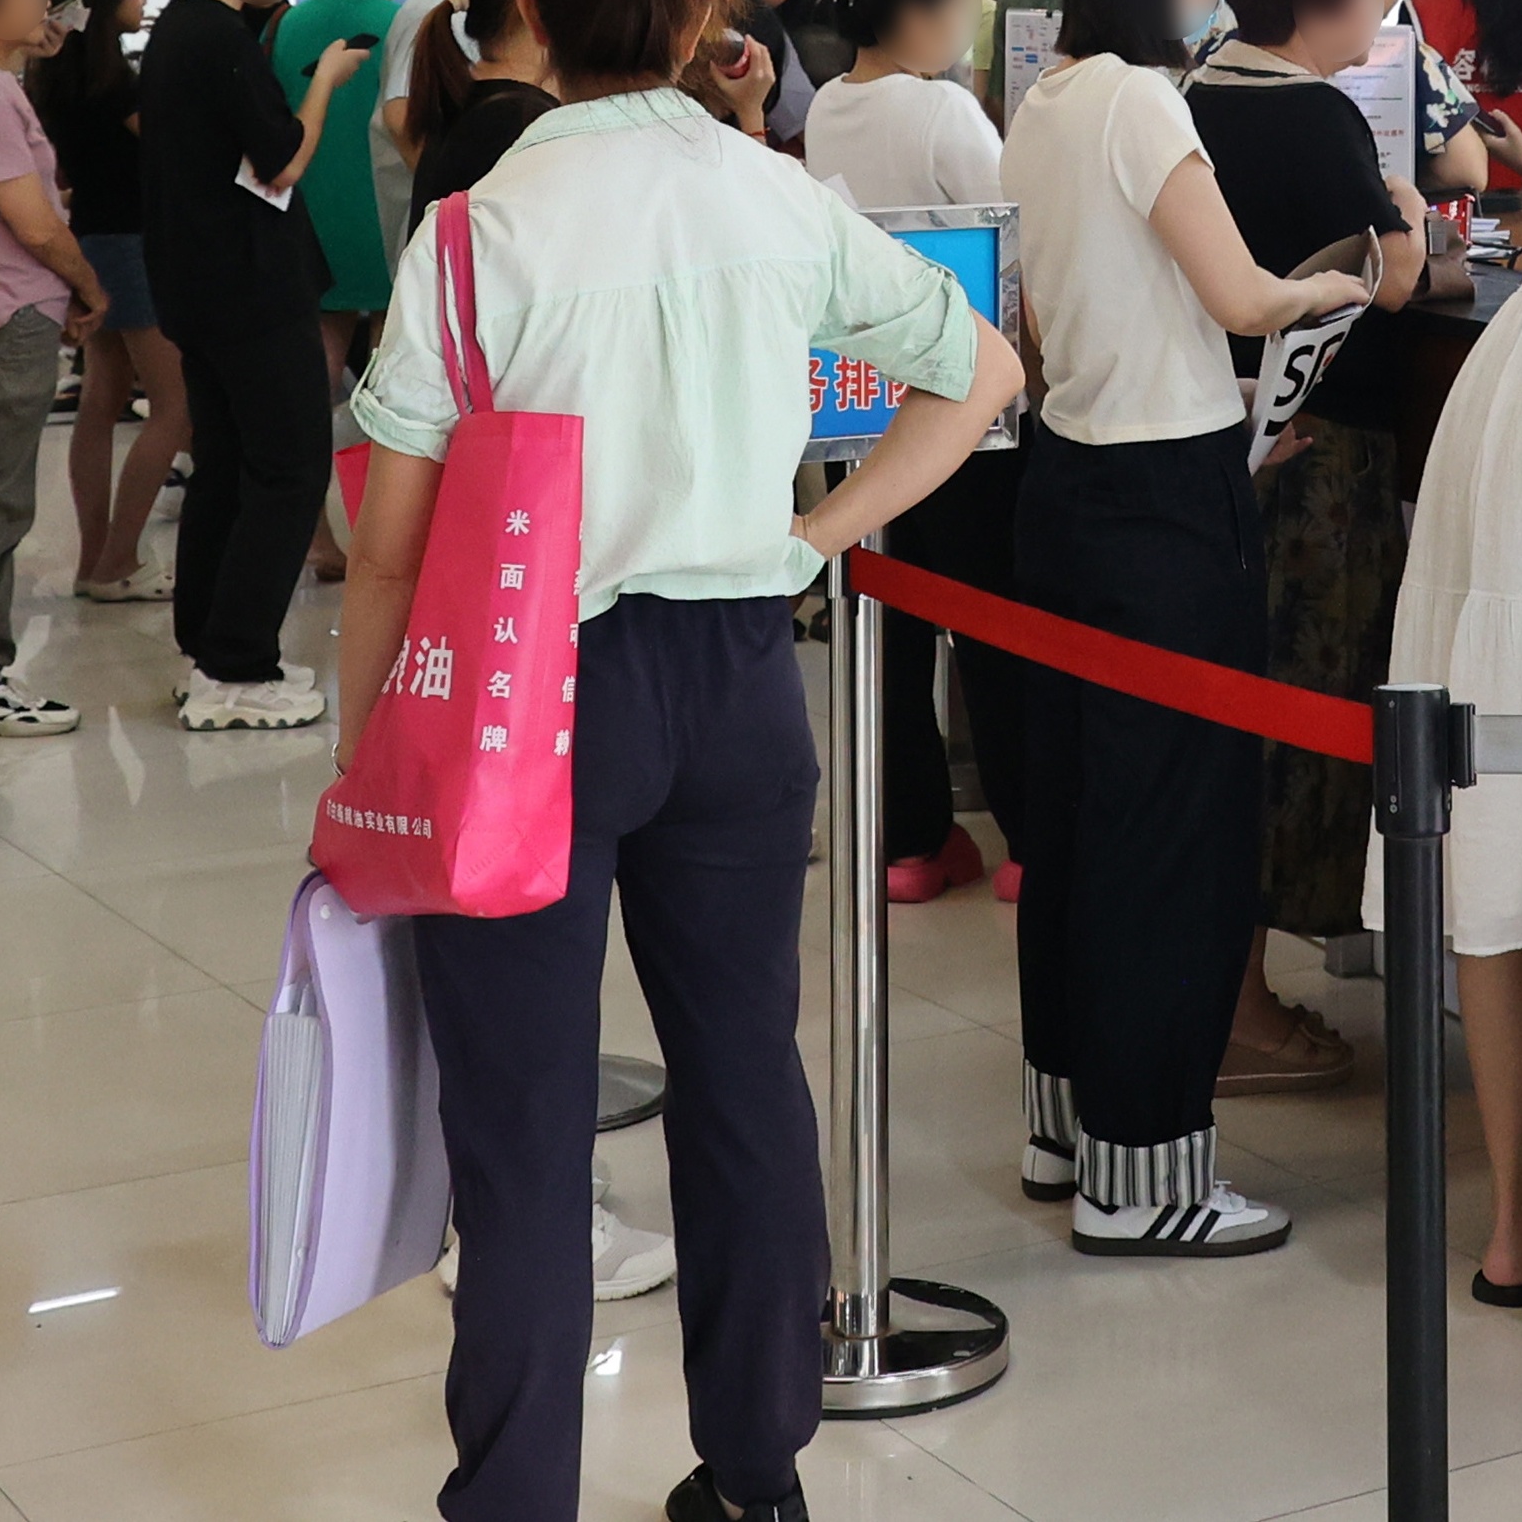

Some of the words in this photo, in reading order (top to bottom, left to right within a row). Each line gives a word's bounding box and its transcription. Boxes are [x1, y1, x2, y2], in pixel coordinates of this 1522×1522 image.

[479, 509, 531, 754] 米面认名牌
